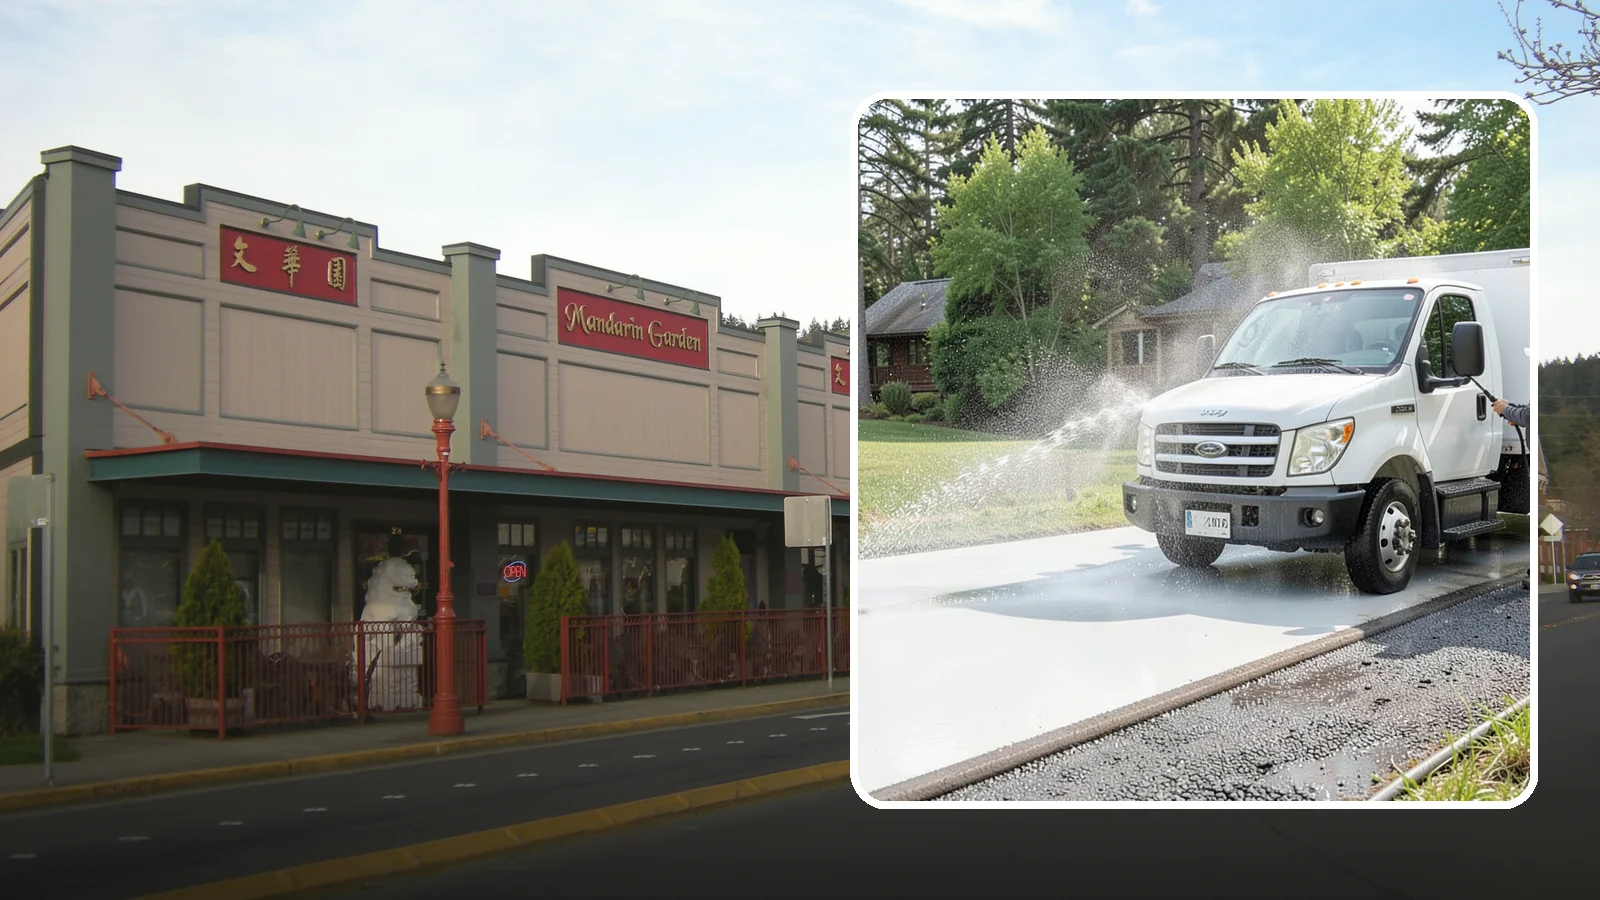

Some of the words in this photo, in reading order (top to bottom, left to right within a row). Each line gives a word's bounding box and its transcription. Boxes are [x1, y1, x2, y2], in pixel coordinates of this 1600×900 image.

[231, 235, 346, 291] 文華園
[564, 302, 644, 341] Mandarin
[648, 320, 701, 352] Garden
[503, 565, 527, 578] OPEN
